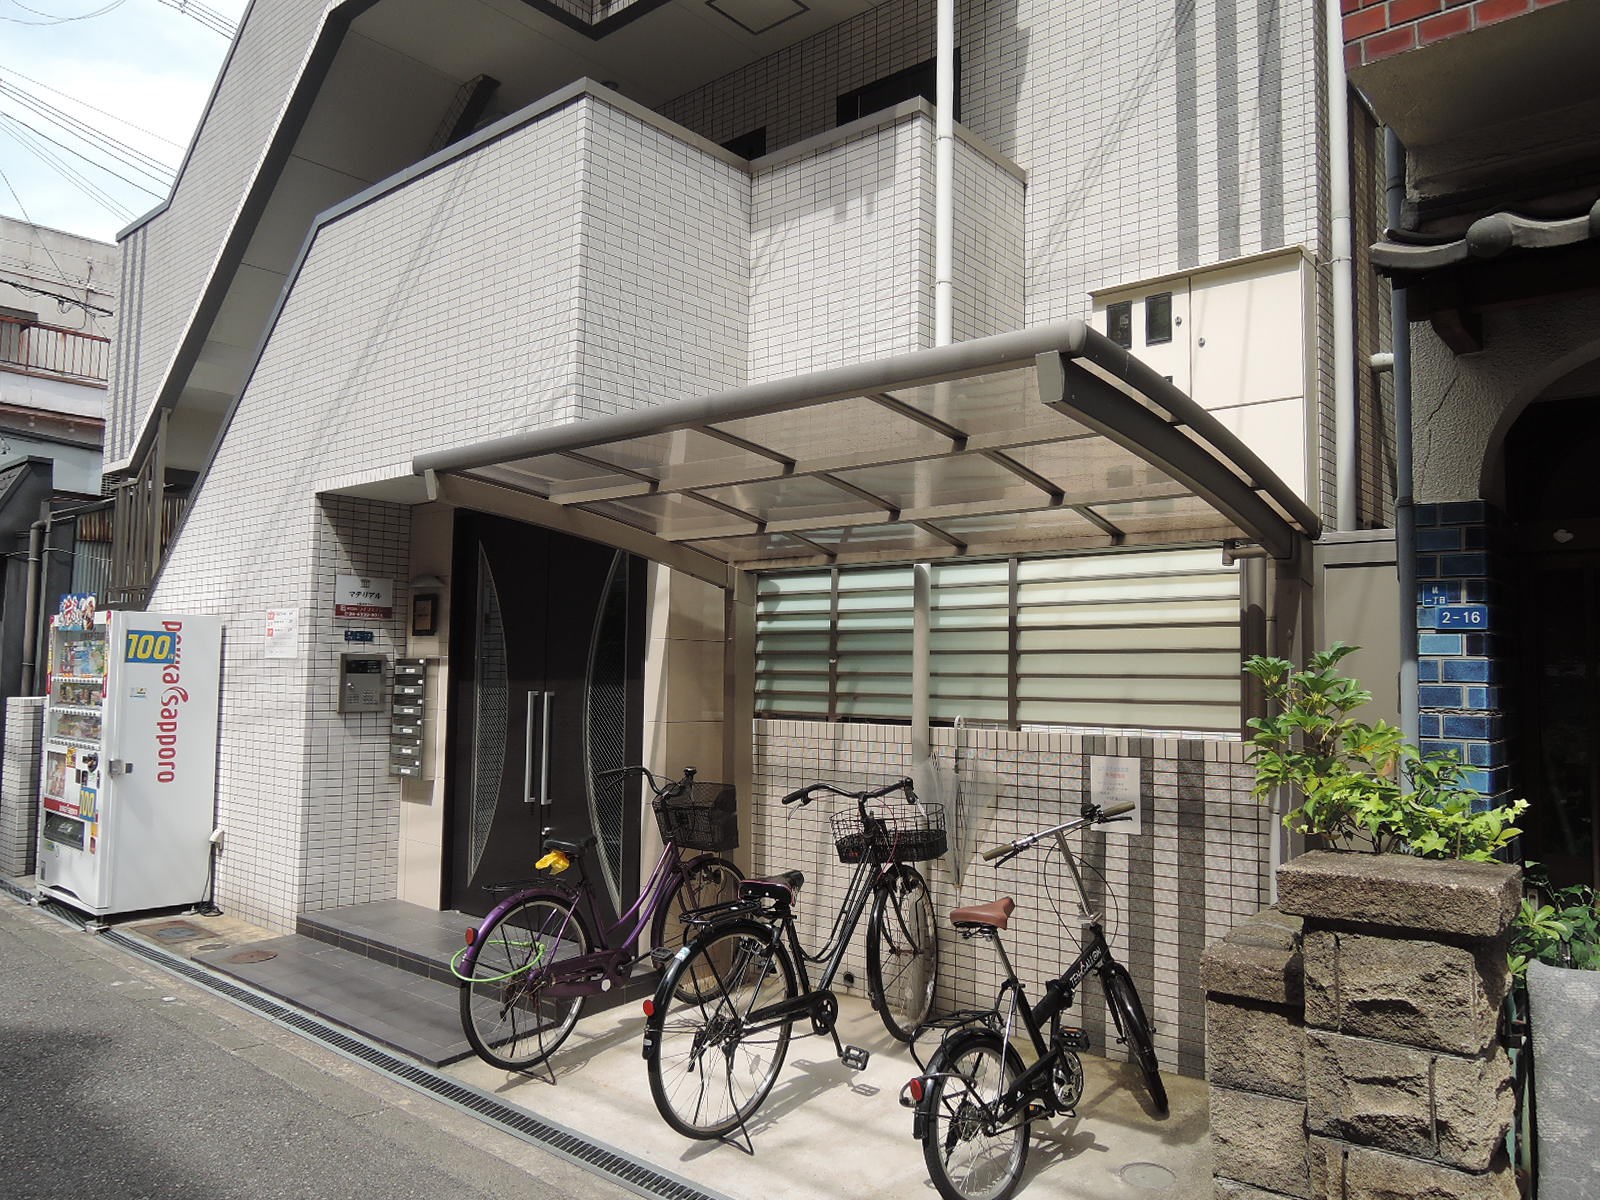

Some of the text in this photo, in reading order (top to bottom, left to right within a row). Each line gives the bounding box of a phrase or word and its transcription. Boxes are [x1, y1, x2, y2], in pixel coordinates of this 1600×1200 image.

[348, 591, 383, 600] マテリアル
[1441, 611, 1481, 624] 2-16
[156, 694, 179, 783] sapporo
